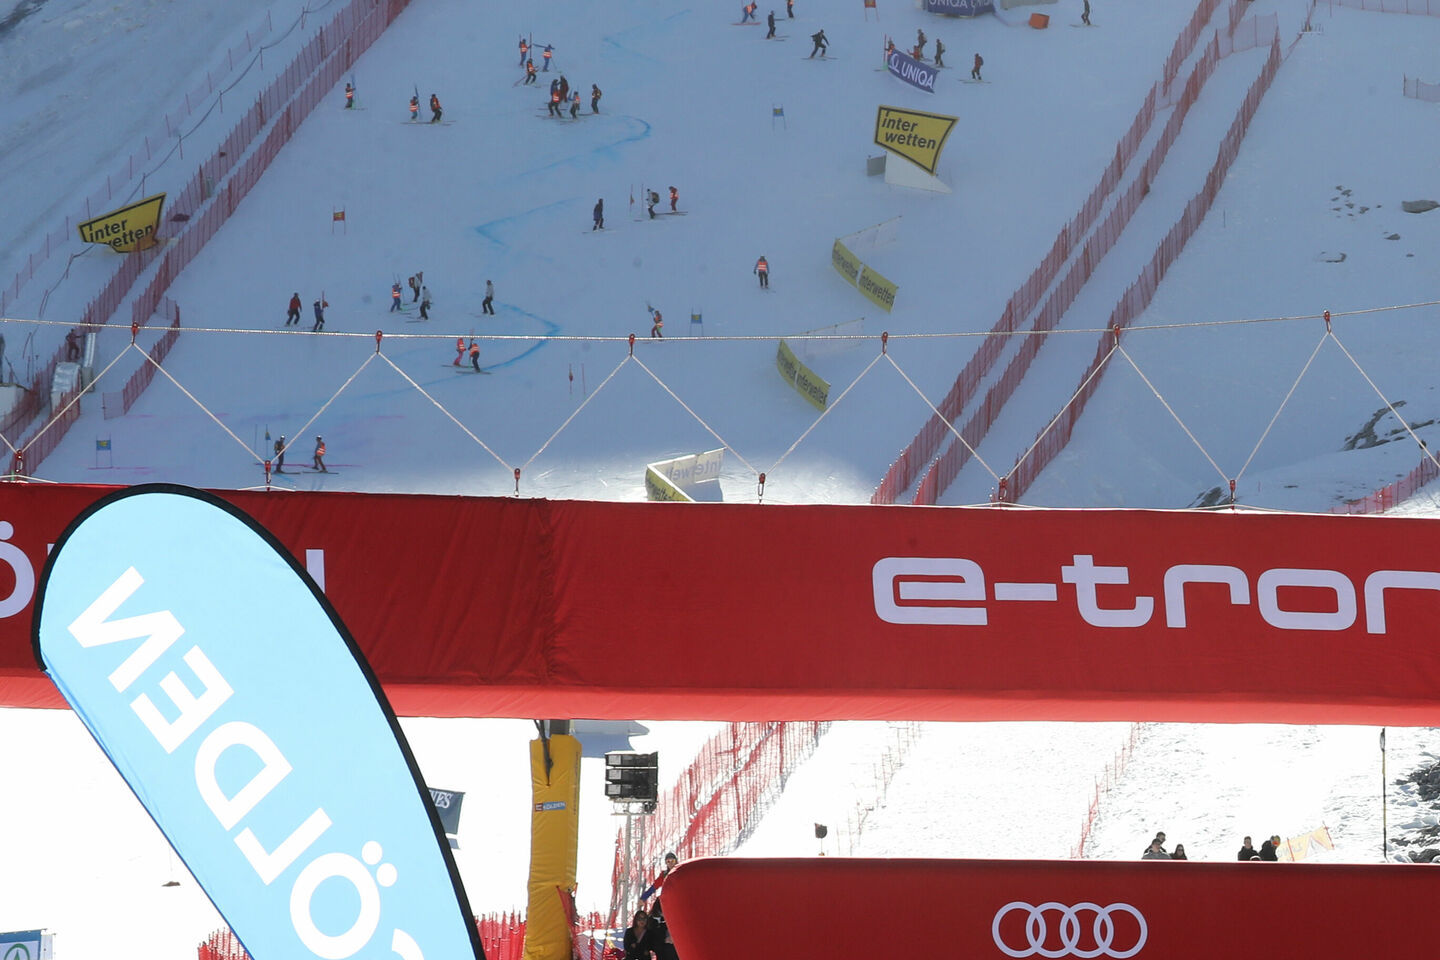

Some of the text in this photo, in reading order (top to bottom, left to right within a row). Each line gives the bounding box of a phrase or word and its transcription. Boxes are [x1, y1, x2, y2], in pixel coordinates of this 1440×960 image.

[901, 64, 934, 89] UNIQA
[881, 111, 918, 132] inter
[884, 131, 937, 150] wetten
[108, 224, 154, 248] etten
